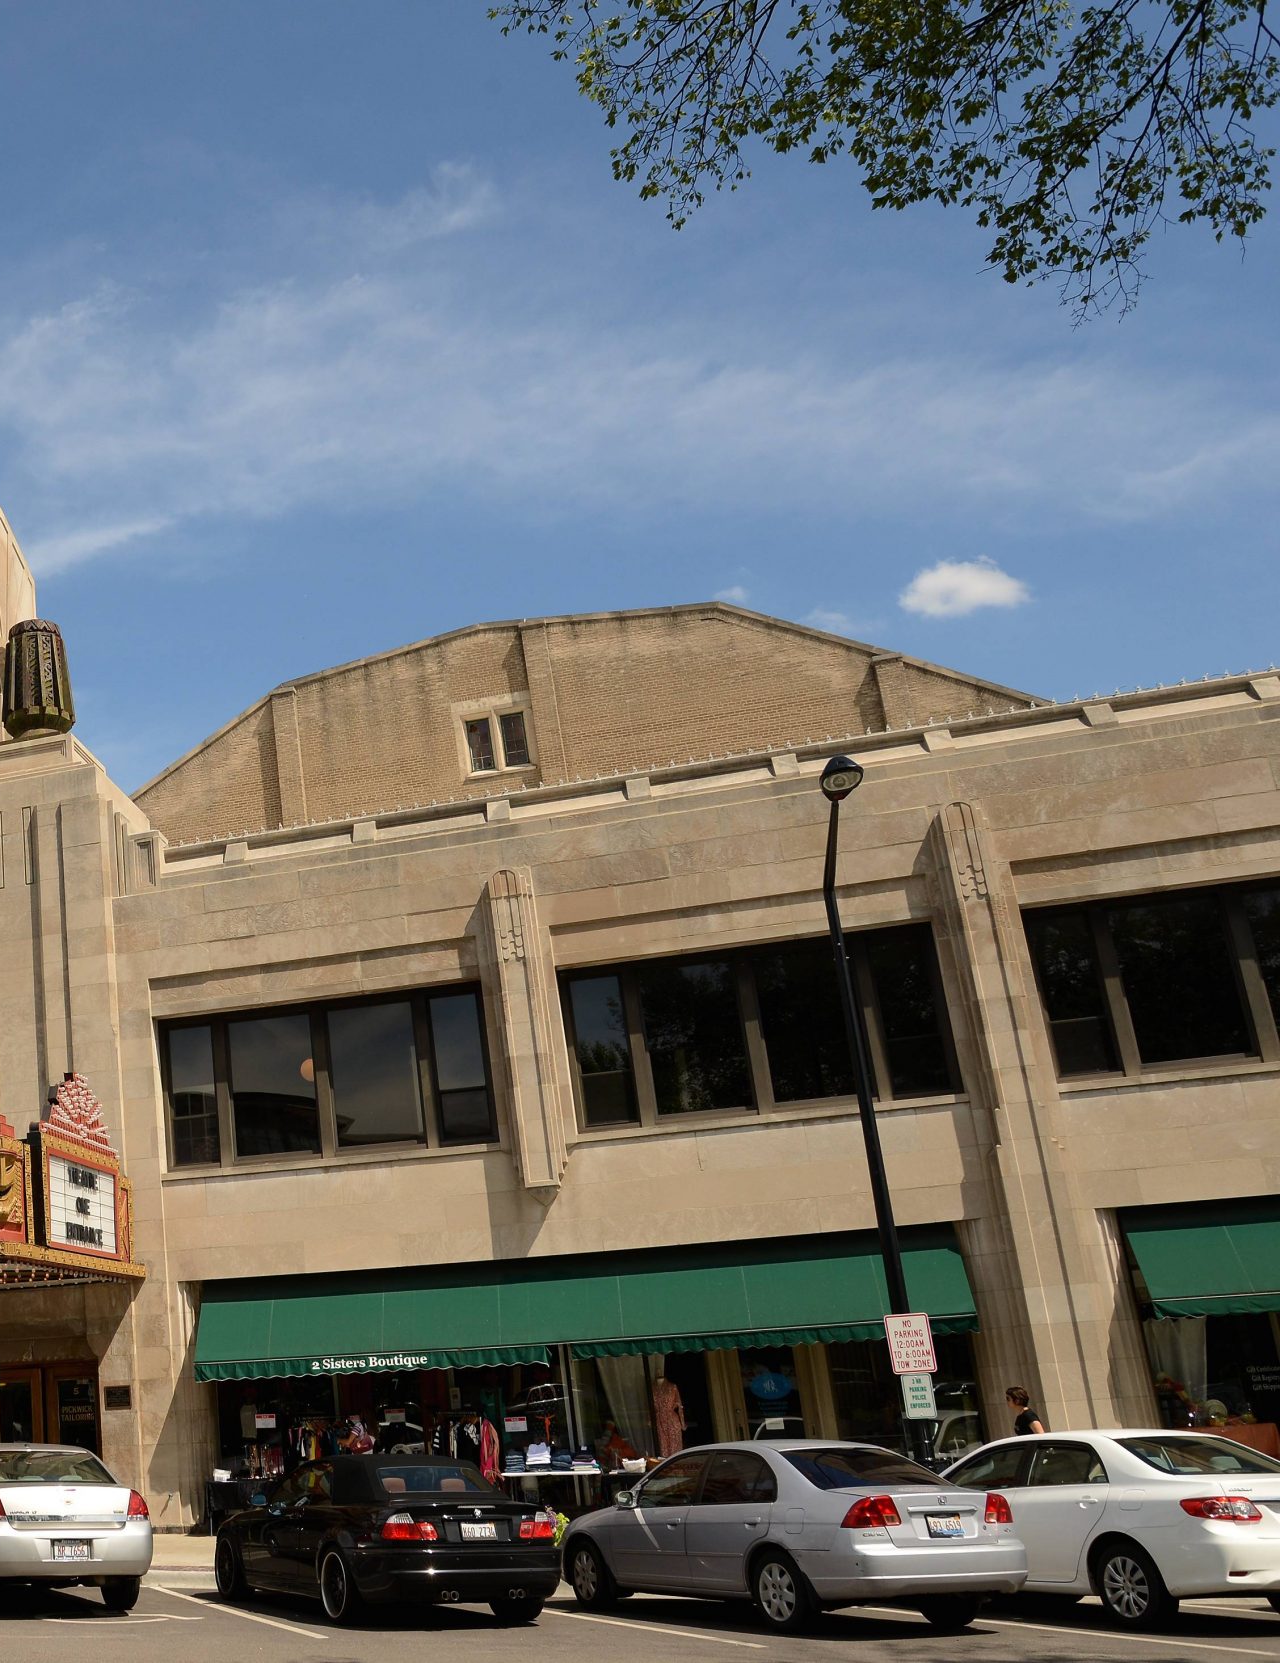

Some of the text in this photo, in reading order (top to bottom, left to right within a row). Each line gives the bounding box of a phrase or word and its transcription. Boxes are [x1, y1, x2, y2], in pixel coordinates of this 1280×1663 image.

[902, 1320, 912, 1328] NO
[894, 1329, 924, 1339] PARKING
[896, 1339, 925, 1349] 12:00AM
[894, 1349, 931, 1359] TO 6:00AM
[311, 1354, 428, 1370] 2 Sisters Boutique
[896, 1359, 932, 1369] TOW ZONE
[391, 1378, 399, 1391] 7
[73, 1387, 79, 1395] 5
[61, 1405, 93, 1414] PICKWICK
[61, 1413, 95, 1422] TAILORING
[945, 1520, 962, 1532] 6519
